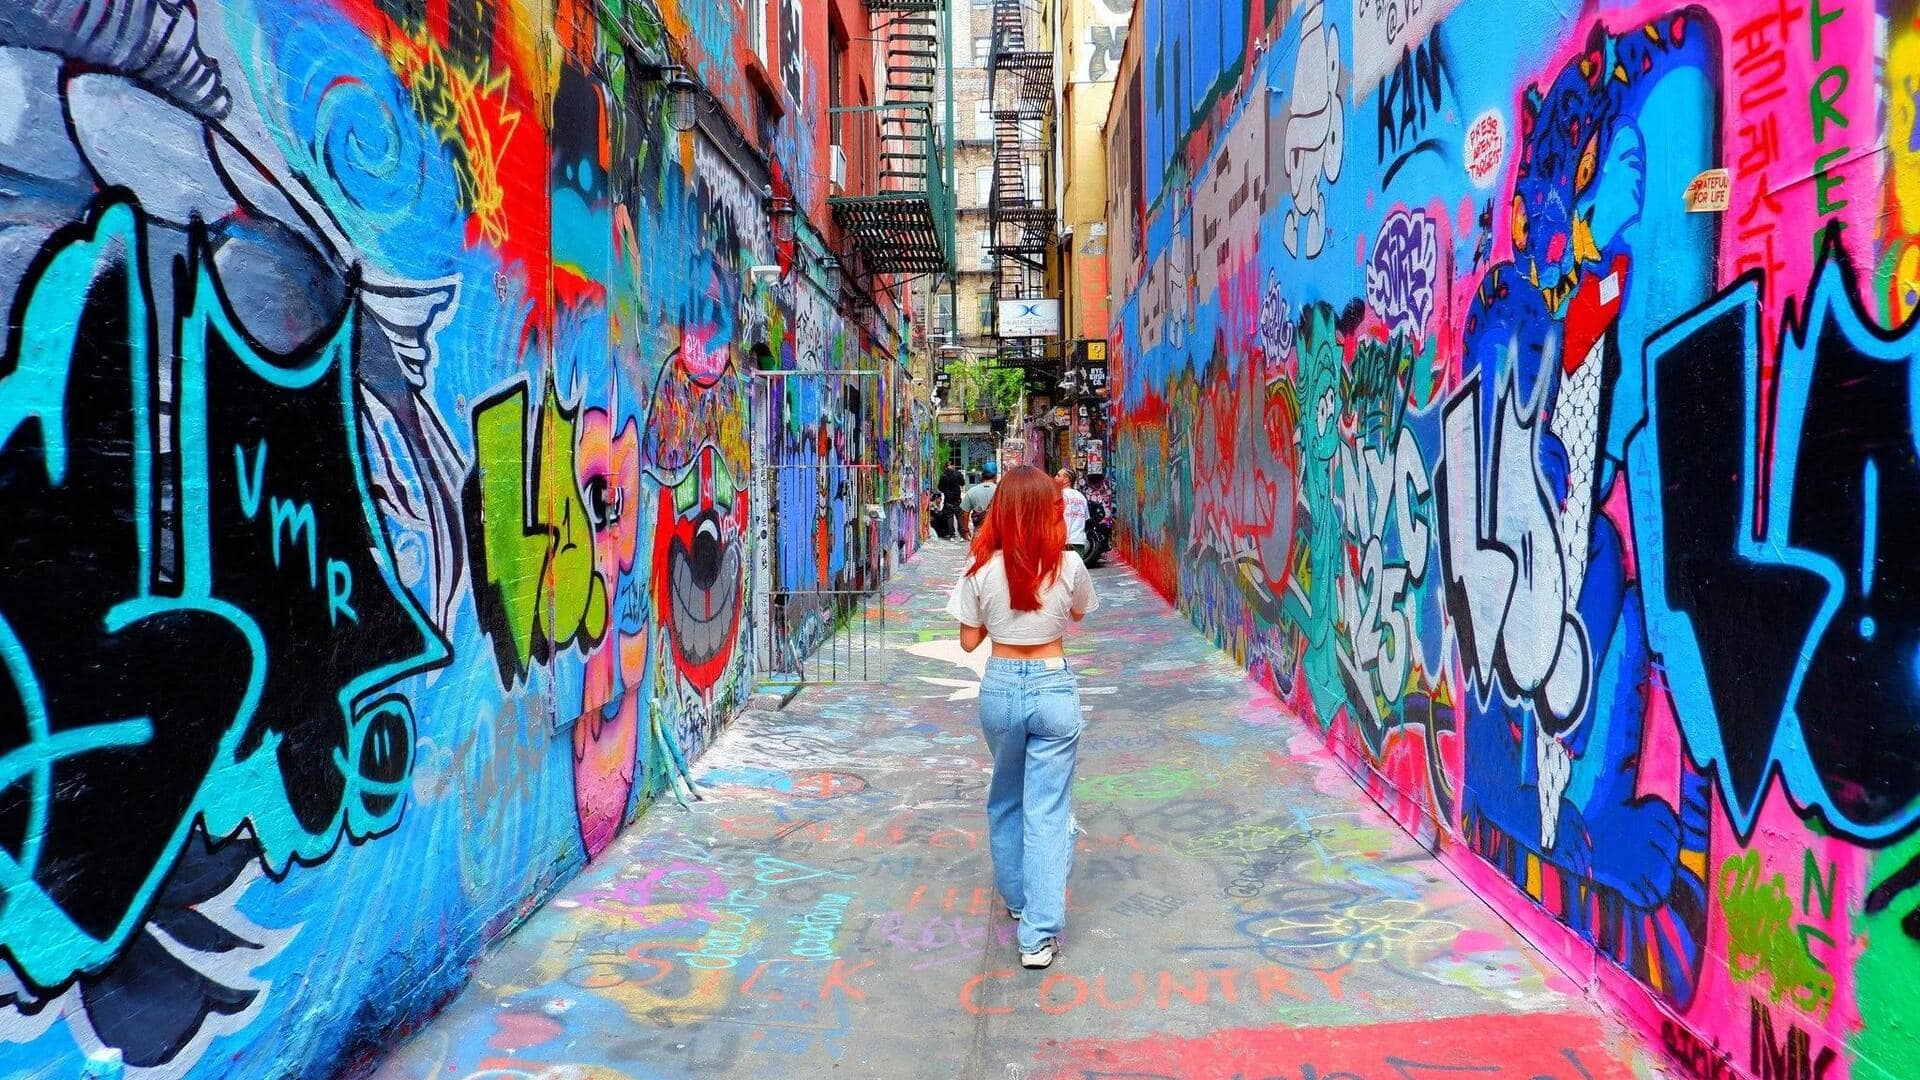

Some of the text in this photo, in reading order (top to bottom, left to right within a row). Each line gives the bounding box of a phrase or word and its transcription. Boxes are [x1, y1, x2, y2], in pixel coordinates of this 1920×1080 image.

[1692, 190, 1725, 204] FOR LIFE
[1339, 424, 1431, 588] NYC
